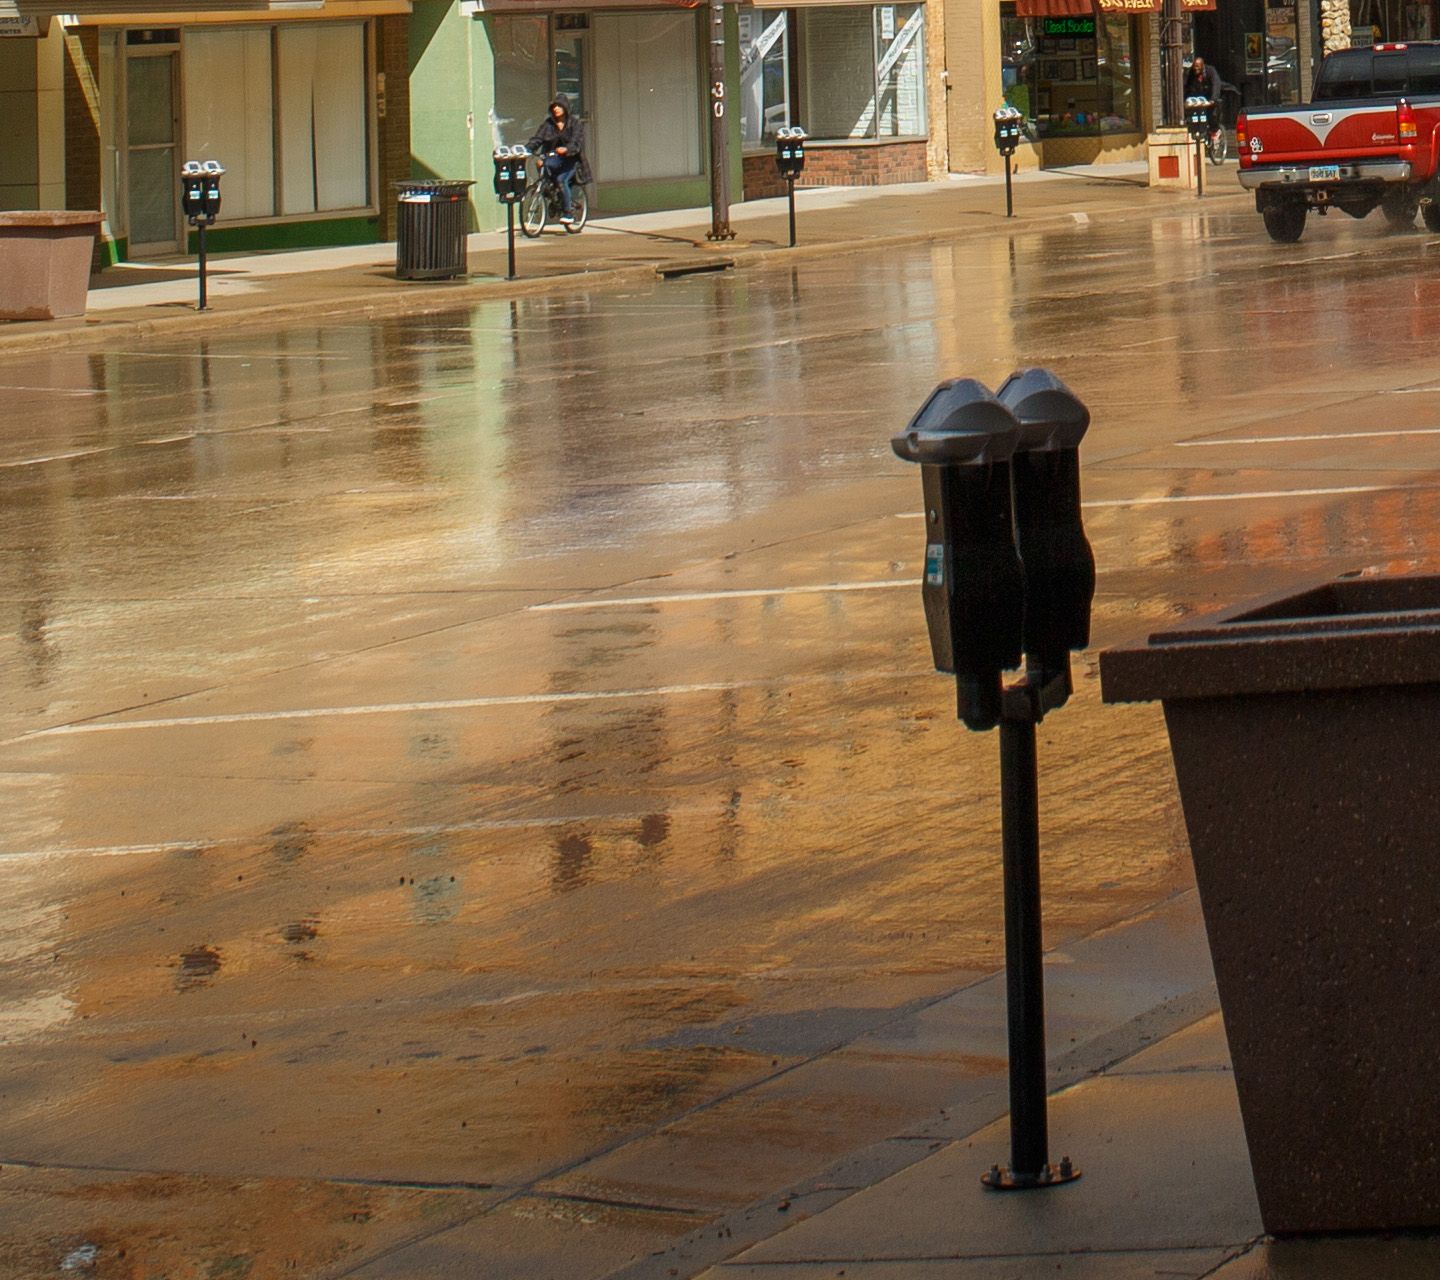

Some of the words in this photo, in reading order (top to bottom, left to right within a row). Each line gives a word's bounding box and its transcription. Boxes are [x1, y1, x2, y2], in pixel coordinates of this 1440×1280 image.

[1045, 20, 1067, 33] Used
[1068, 19, 1094, 33] Books
[712, 82, 724, 117] 30
